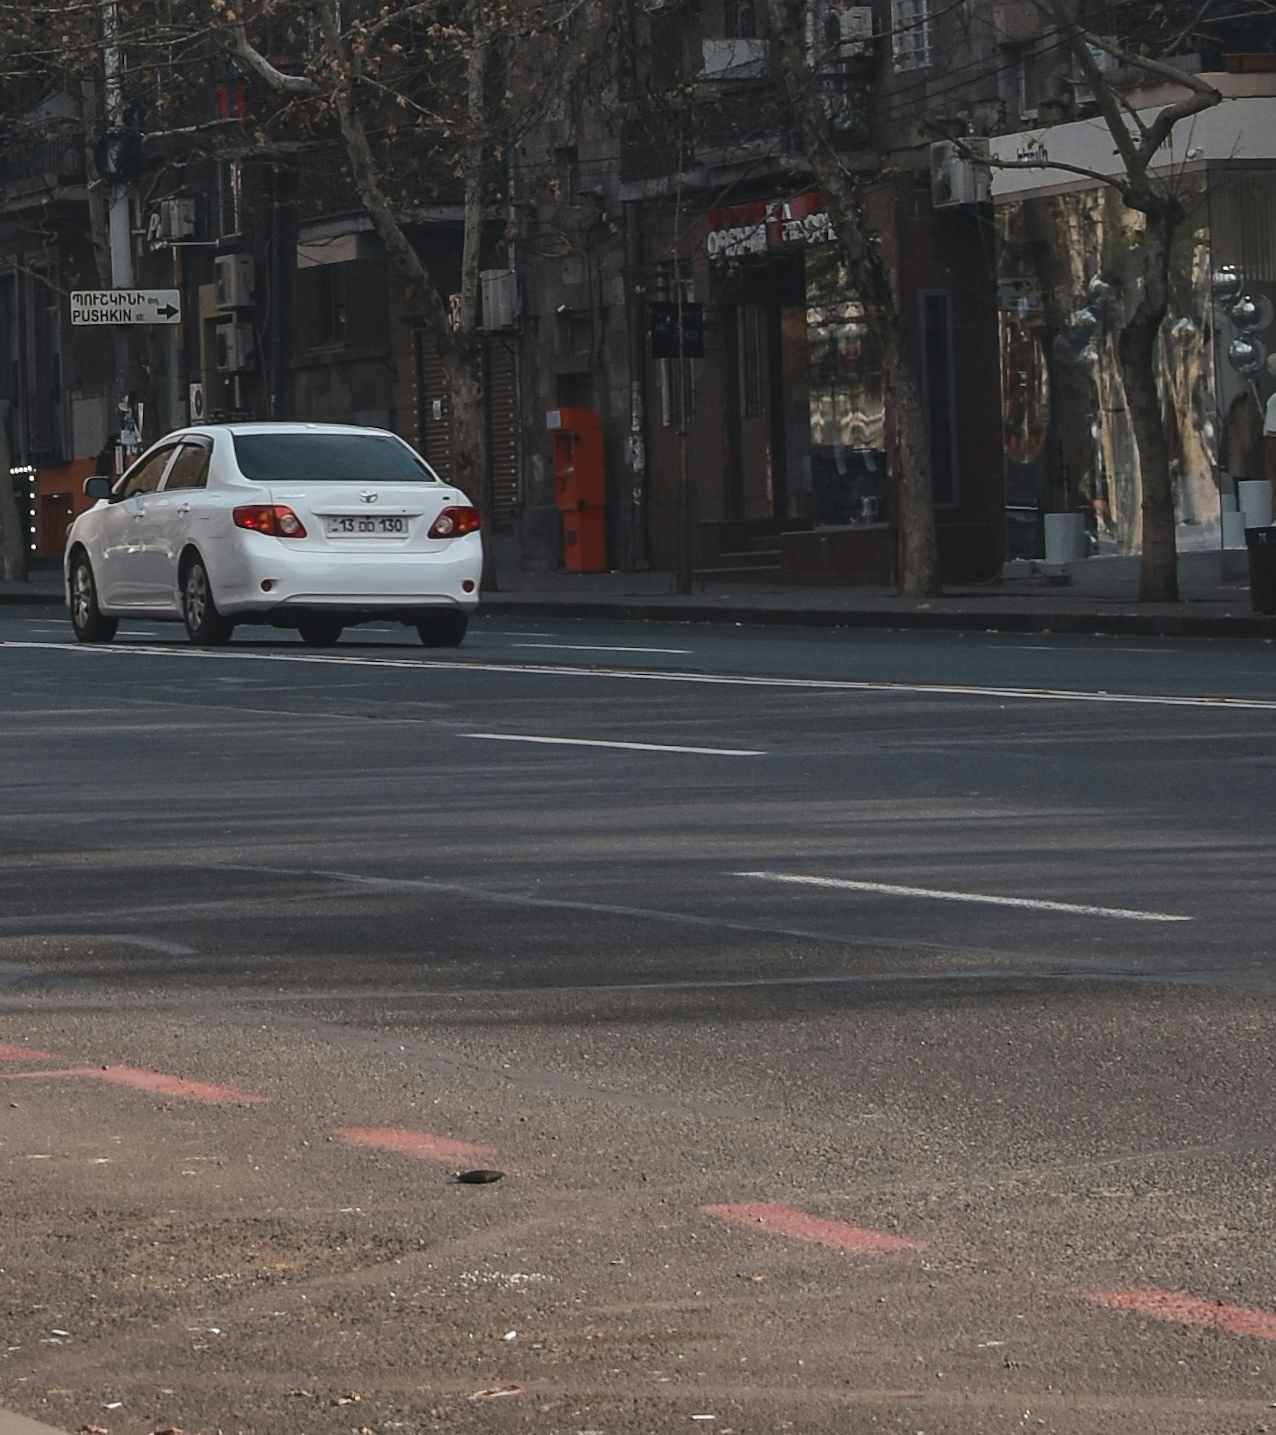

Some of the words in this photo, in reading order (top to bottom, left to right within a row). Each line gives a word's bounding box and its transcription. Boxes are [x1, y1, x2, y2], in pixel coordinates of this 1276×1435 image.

[72, 292, 146, 306] ՊՈՒՇԿԻՆԻ
[72, 309, 132, 322] PUSHKIN
[339, 519, 355, 532] 13
[358, 522, 375, 532] DD
[379, 519, 403, 532] 130
